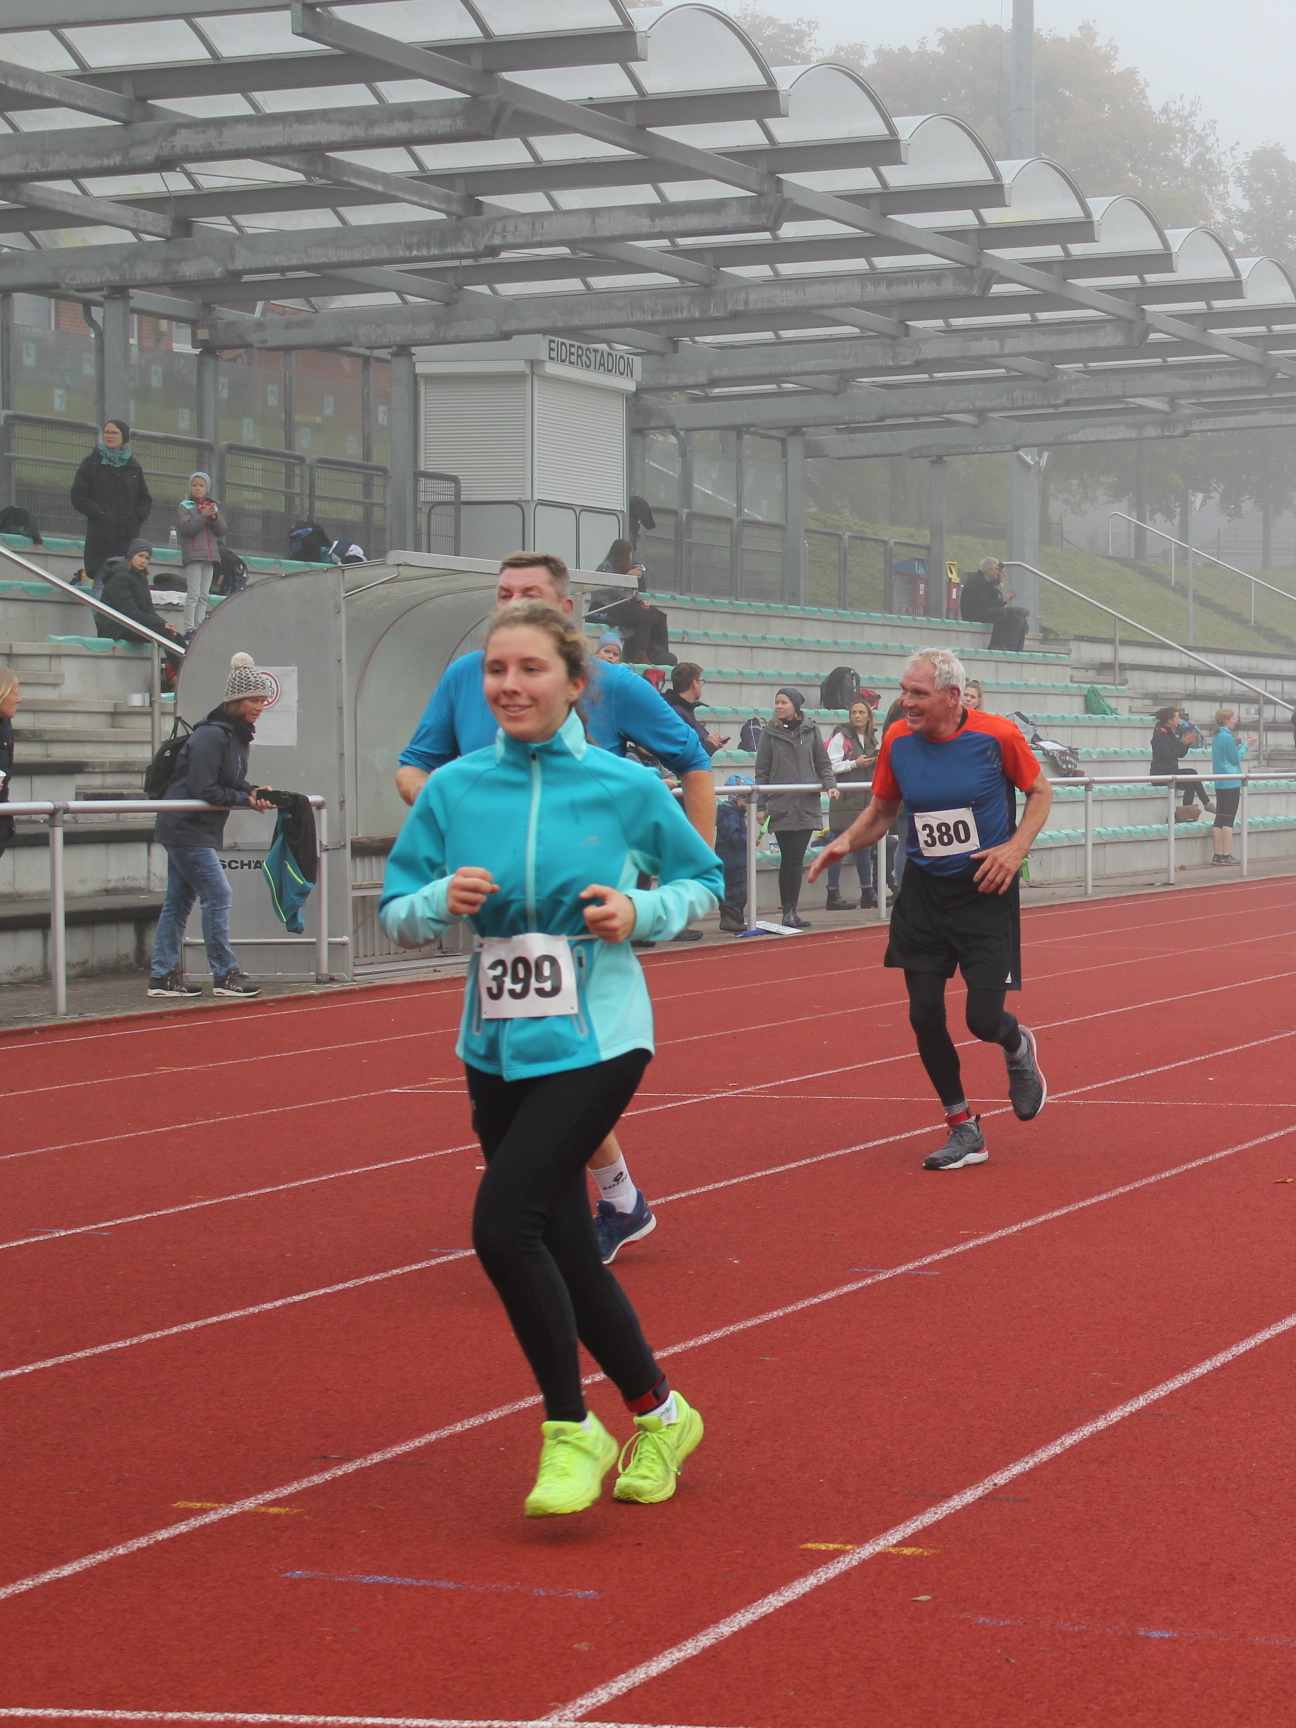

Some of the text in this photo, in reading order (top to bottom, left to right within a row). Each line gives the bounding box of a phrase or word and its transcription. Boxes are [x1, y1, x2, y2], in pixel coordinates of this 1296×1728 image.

[548, 339, 634, 377] EIDERSTADION
[922, 820, 971, 847] 380
[486, 954, 562, 1001] 399
